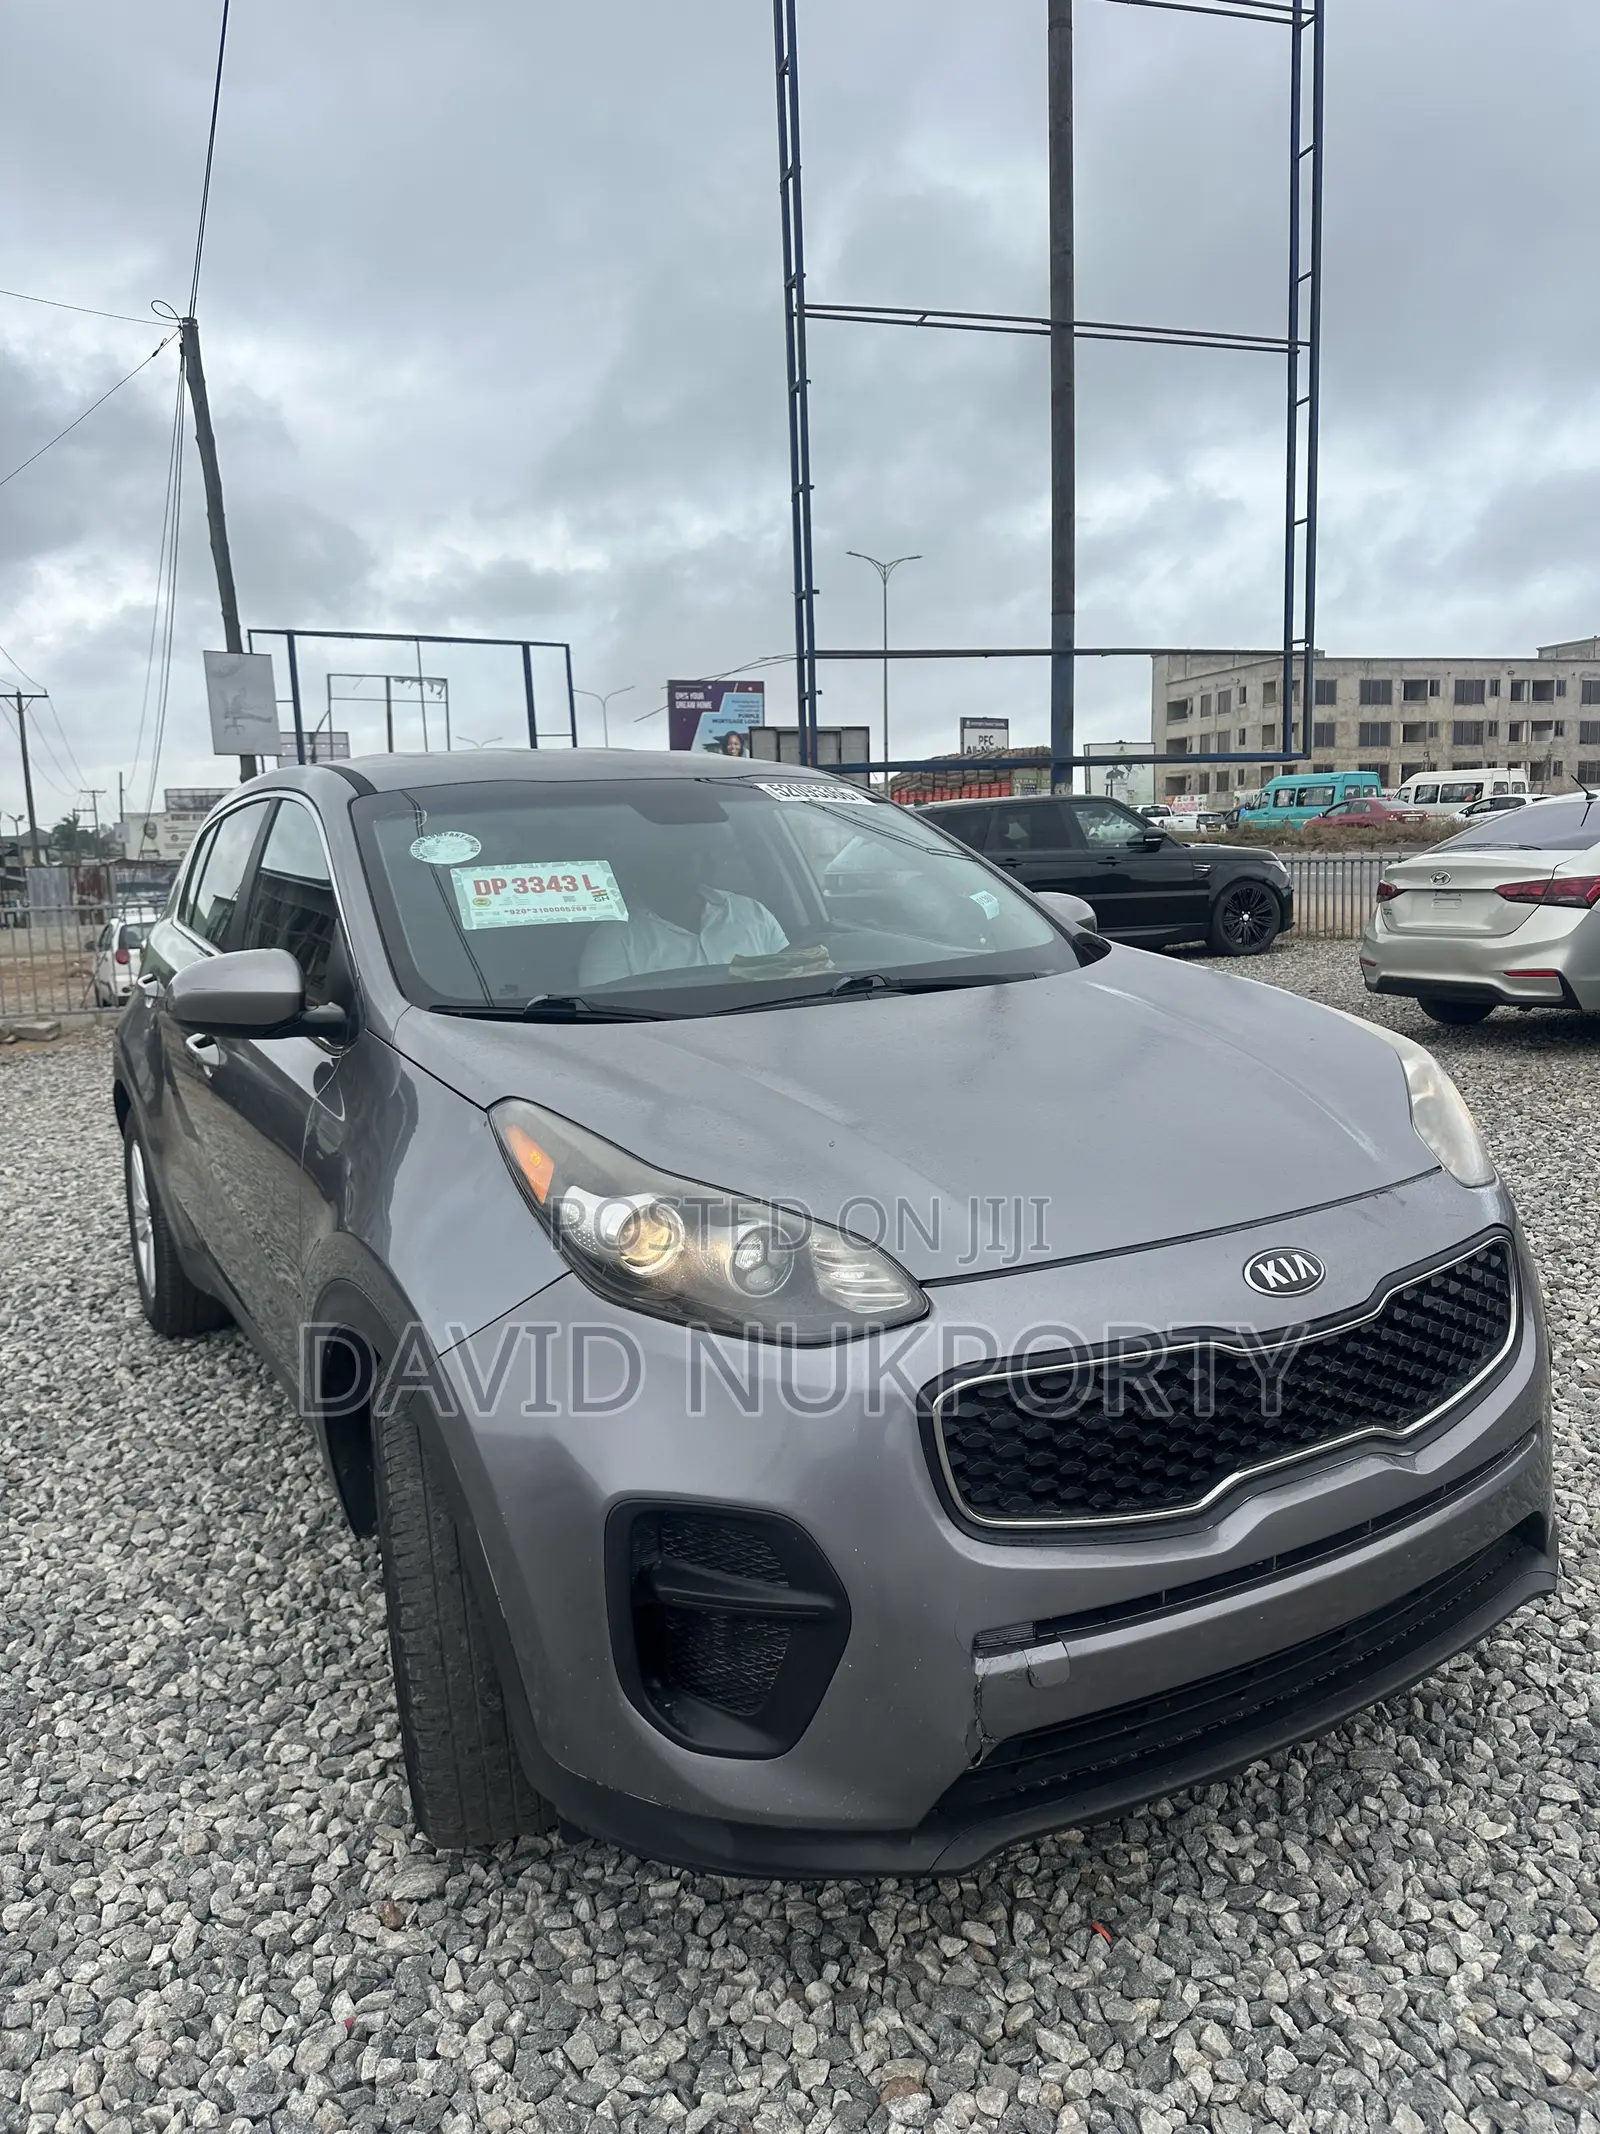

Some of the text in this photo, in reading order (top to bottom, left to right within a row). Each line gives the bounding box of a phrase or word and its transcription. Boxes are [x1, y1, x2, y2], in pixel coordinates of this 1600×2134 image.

[696, 701, 713, 709] HOME
[978, 735, 994, 746] PFC
[473, 874, 601, 896] DP 3343 L
[1254, 1253, 1319, 1289] KIA
